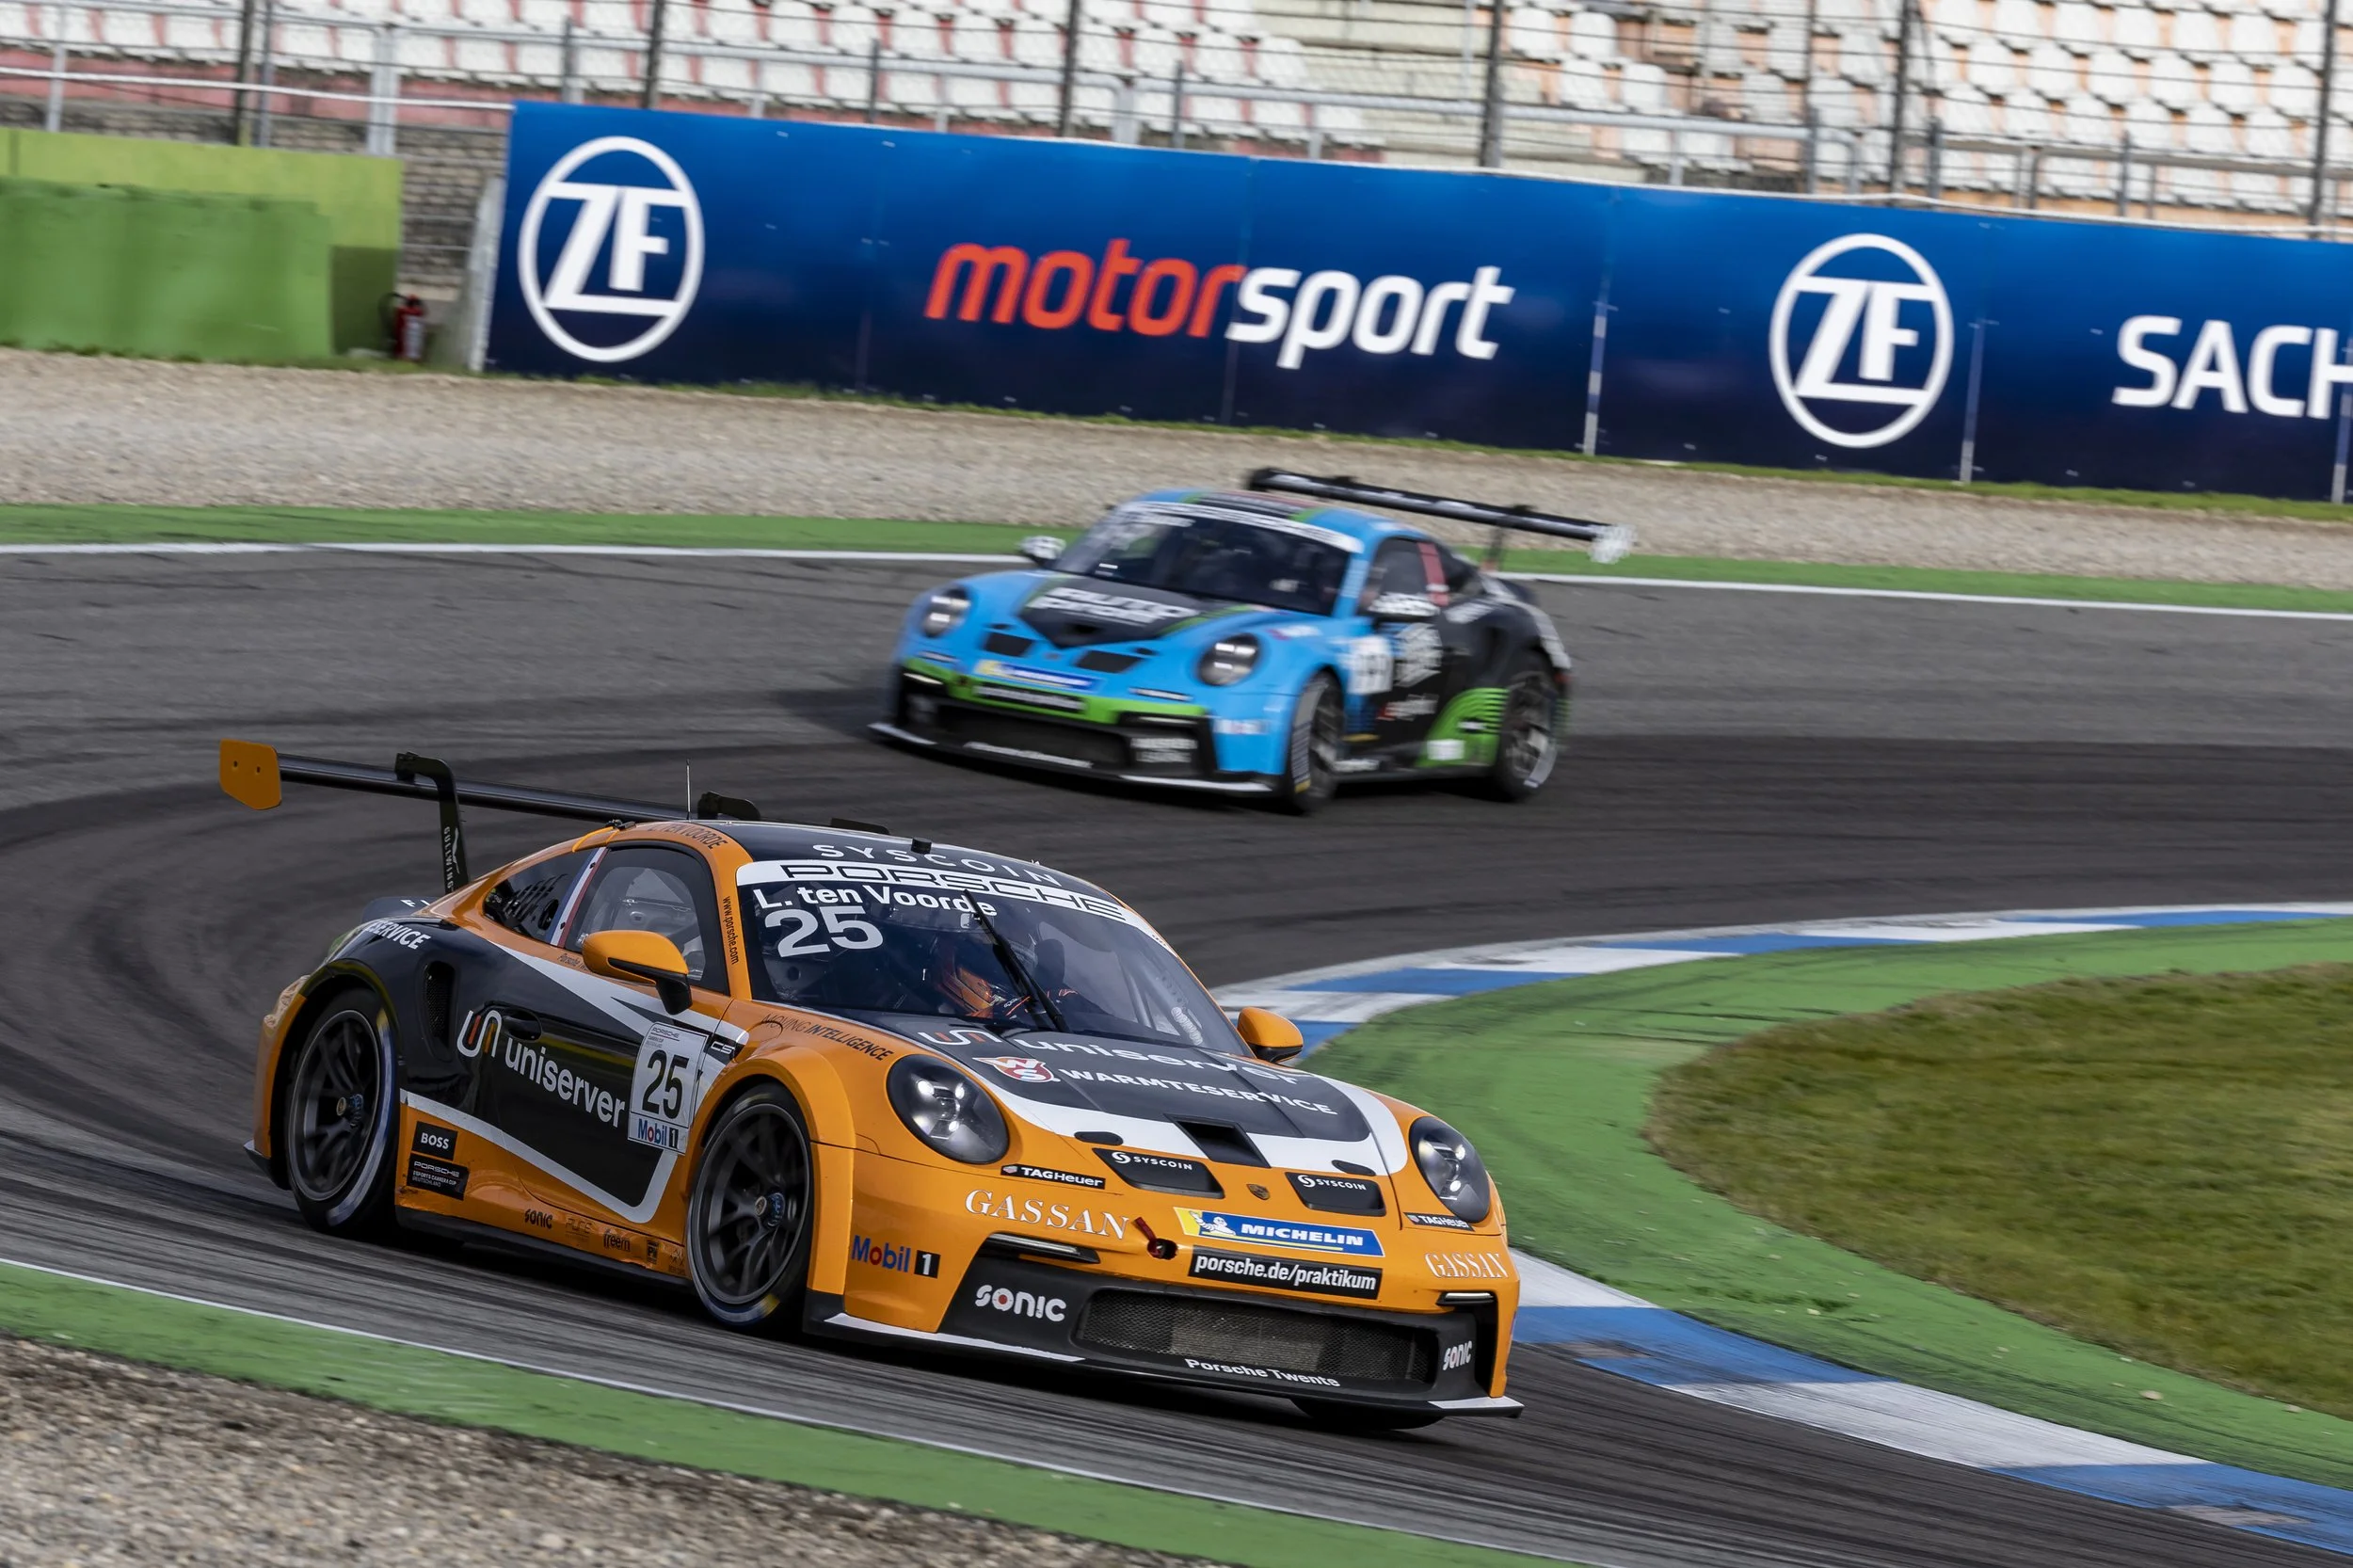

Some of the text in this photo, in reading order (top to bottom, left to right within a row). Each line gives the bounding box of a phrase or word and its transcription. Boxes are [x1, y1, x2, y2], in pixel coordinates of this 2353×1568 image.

[923, 238, 1516, 370] motorsport
[812, 844, 1062, 887] SYSCOIN
[753, 888, 792, 909] L.
[796, 886, 863, 904] ten
[780, 864, 1127, 921] PORSCHE
[722, 895, 740, 966] www.porsche.com
[764, 905, 884, 958] 25
[760, 1013, 894, 1062] MOVING INTELLIGENCE
[1015, 1038, 1301, 1085] uniserver
[504, 1036, 626, 1128] uniserver
[642, 1049, 690, 1120] 25
[1057, 1067, 1338, 1115] WARMTESERVICE
[421, 1132, 450, 1150] BOSS
[637, 1118, 667, 1146] Mobil
[413, 1160, 460, 1178] PORSCHE
[1133, 1155, 1193, 1171] SYSCOIN
[1316, 1177, 1368, 1191] SYSCOIN
[965, 1189, 1130, 1240] GASSAN
[851, 1235, 912, 1273] Mobil
[1241, 1224, 1364, 1246] MICHELIN
[1194, 1255, 1377, 1290] porsche.de/praktikum
[1424, 1253, 1509, 1278] GASSAN
[1184, 1358, 1341, 1387] Porsche Twente
